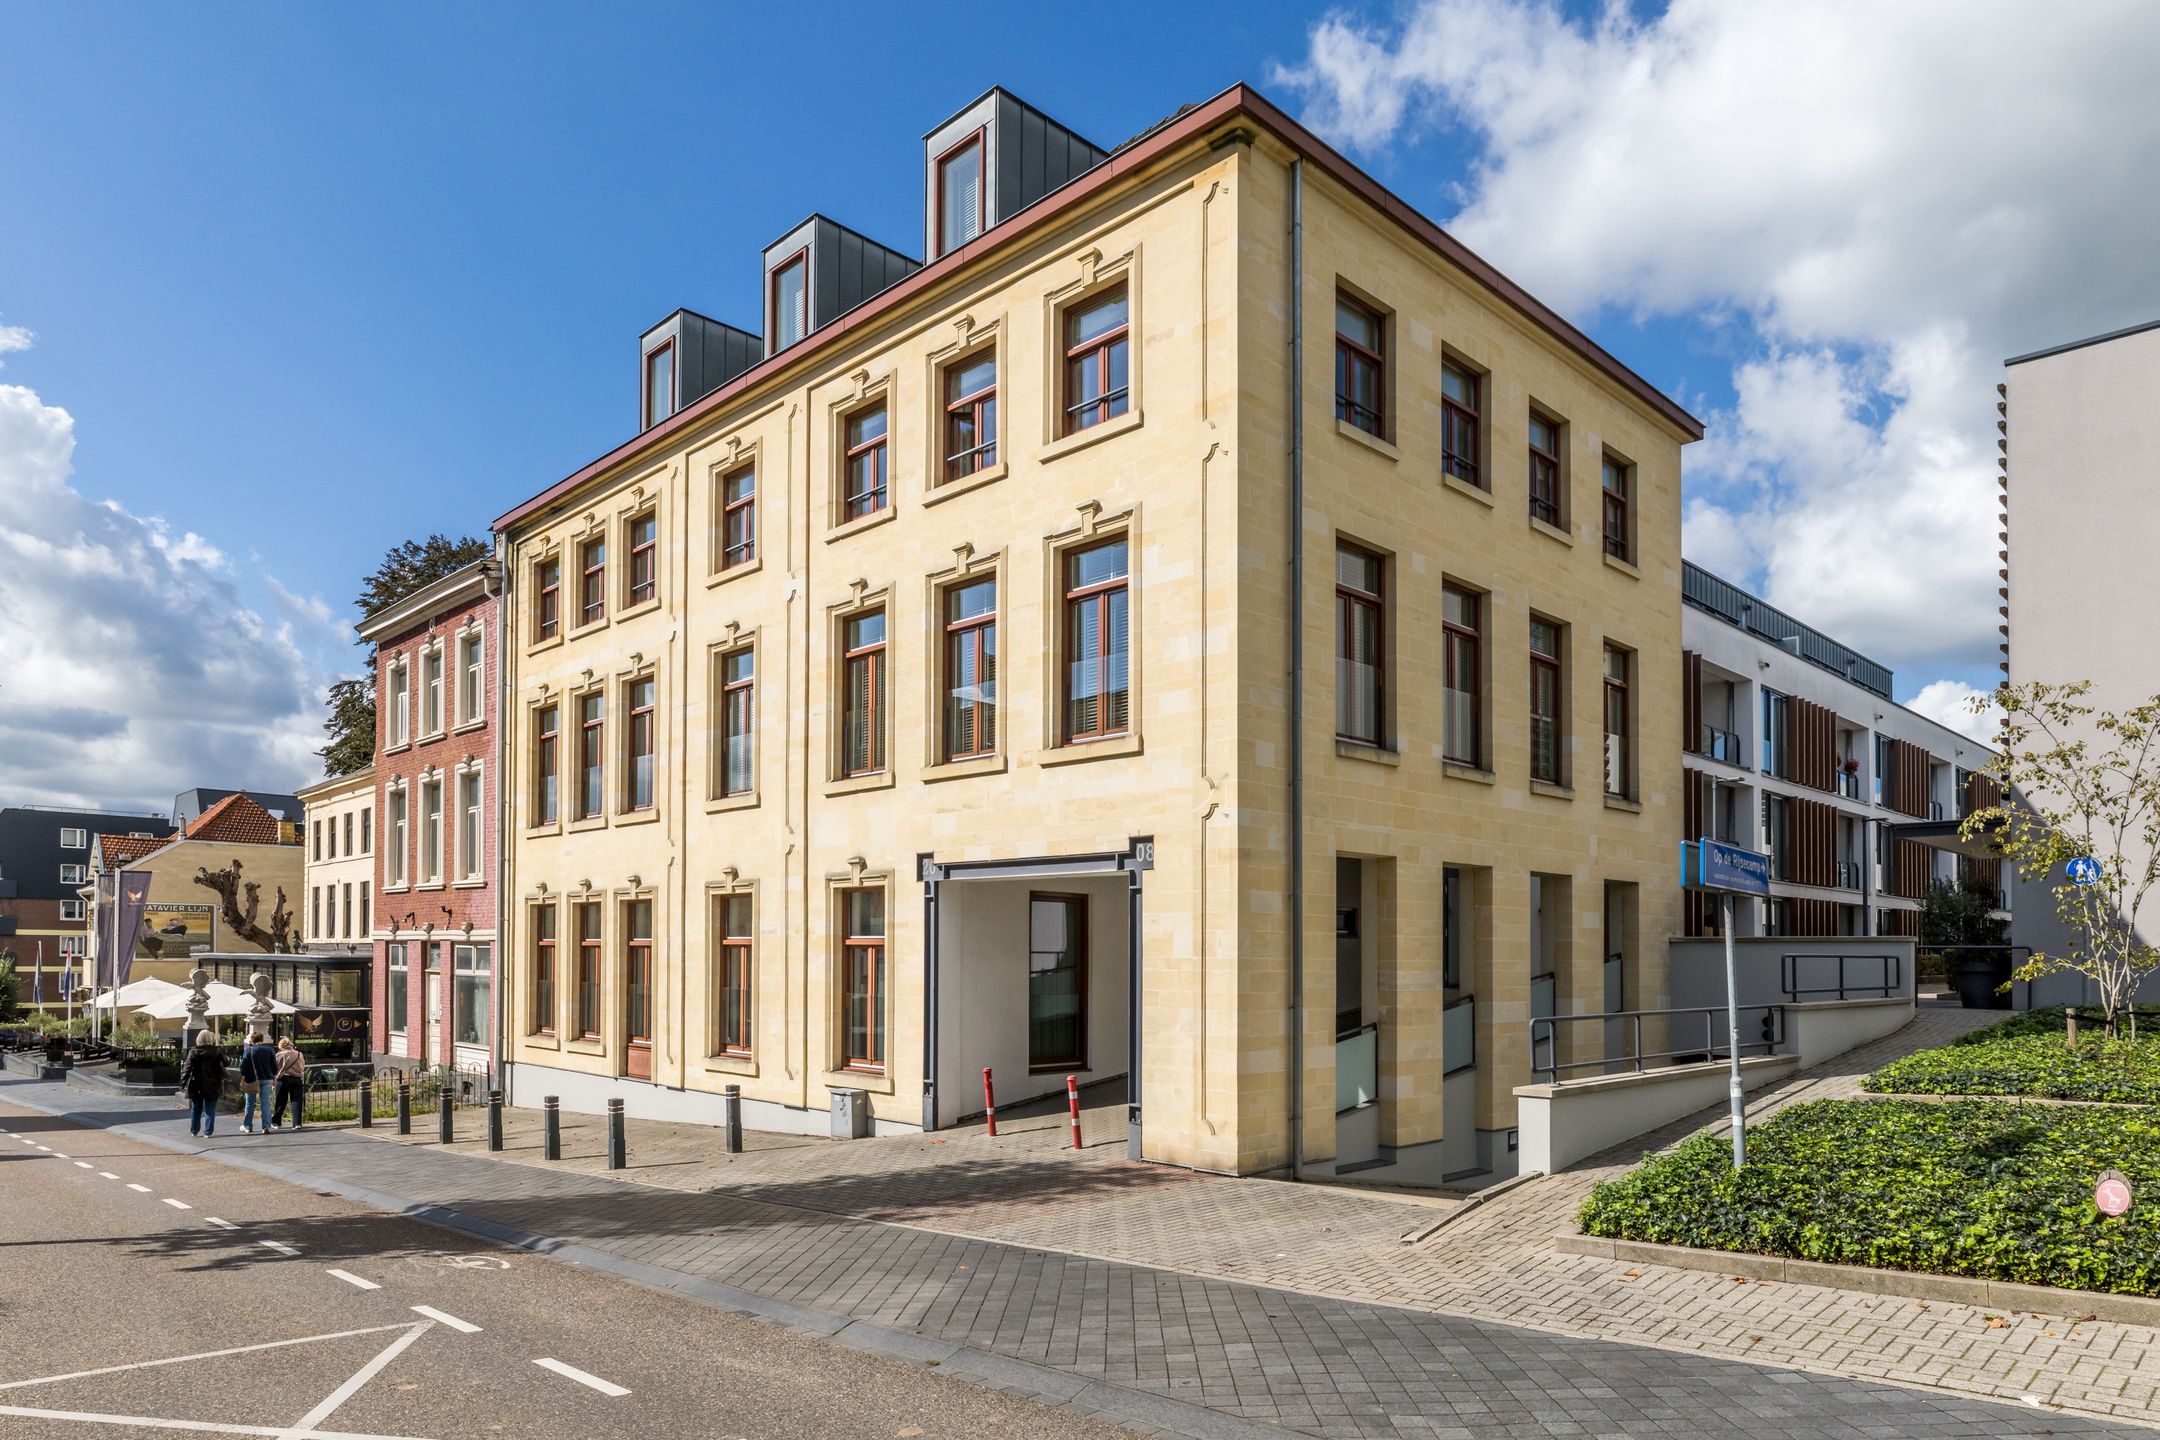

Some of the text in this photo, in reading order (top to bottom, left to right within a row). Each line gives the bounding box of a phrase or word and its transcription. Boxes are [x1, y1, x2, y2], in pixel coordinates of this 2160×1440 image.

[1136, 843, 1154, 862] 08
[1713, 849, 1723, 867] Op
[1724, 851, 1732, 865] de
[923, 858, 936, 875] 20
